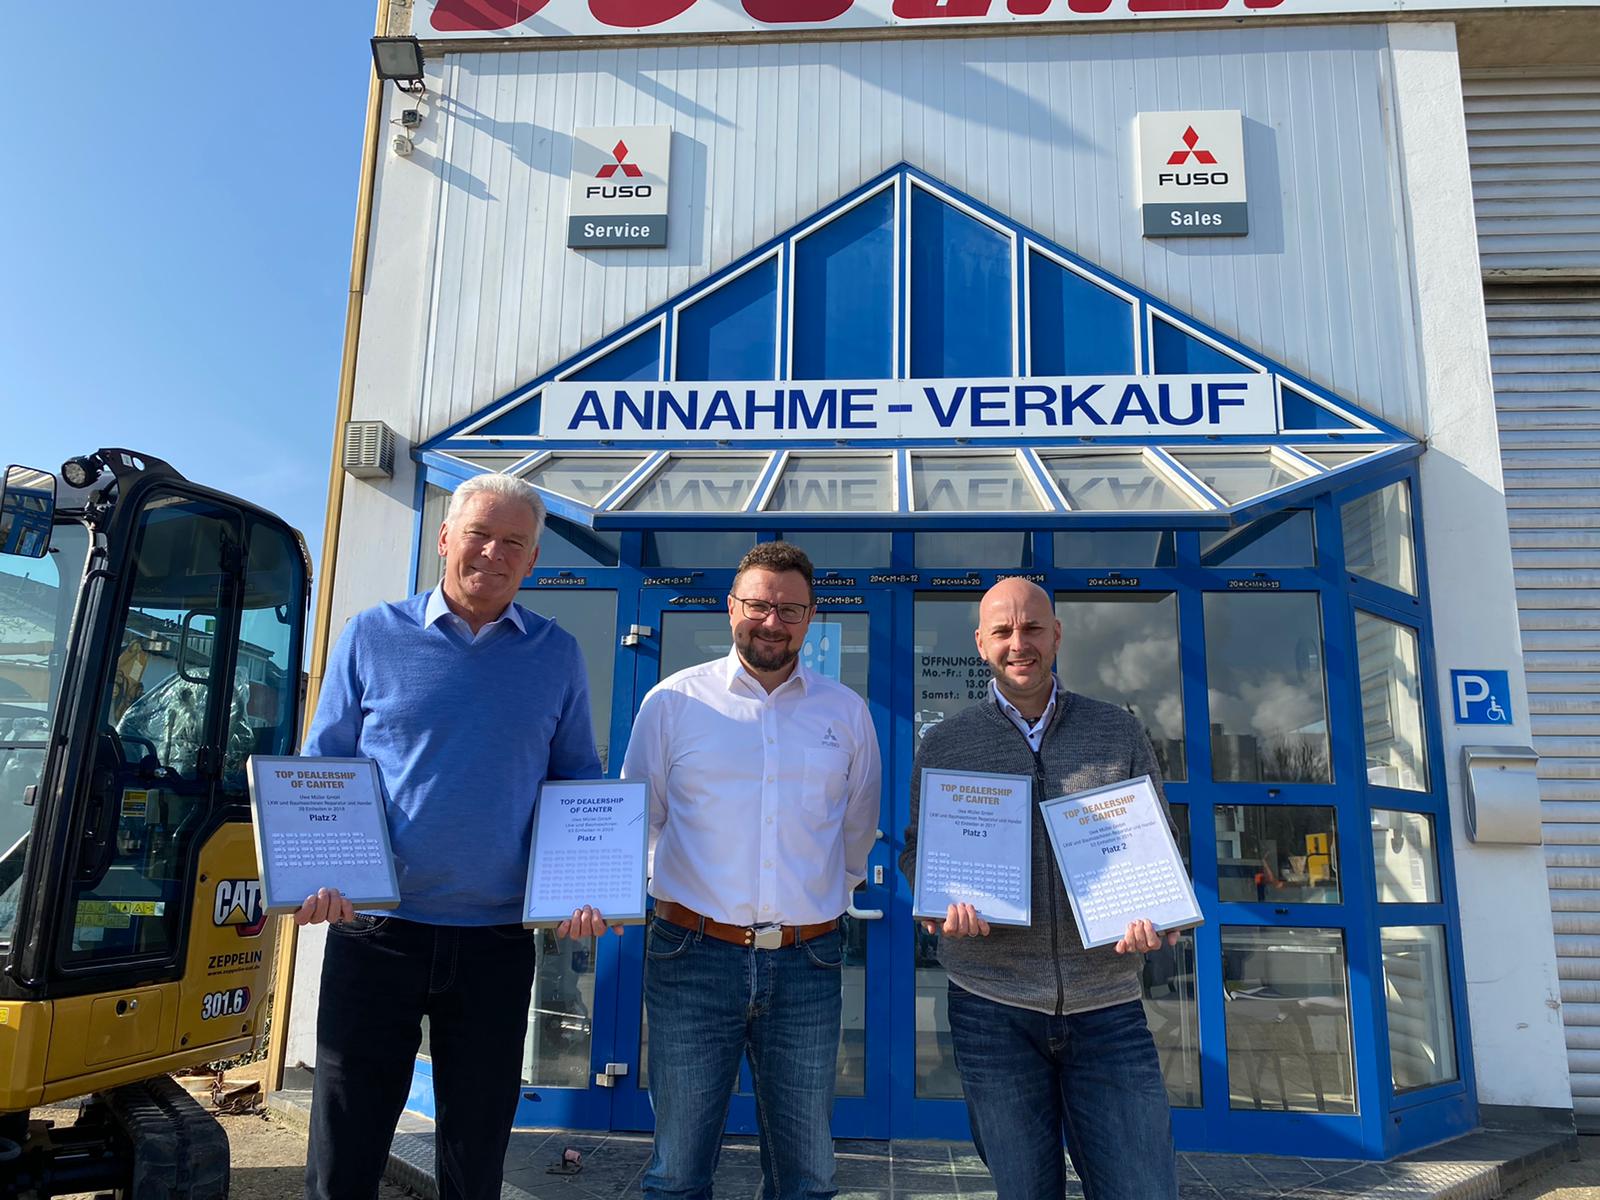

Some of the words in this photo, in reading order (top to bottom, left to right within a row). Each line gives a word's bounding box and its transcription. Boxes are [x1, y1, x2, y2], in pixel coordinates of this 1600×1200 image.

[1159, 172, 1228, 186] FUSO
[586, 185, 652, 199] FUSO
[1170, 211, 1222, 226] Sales
[584, 223, 650, 238] Service
[968, 668, 991, 677] 8.00
[922, 690, 960, 699] Samst.:
[1457, 676, 1490, 718] P
[275, 770, 294, 779] TOP
[297, 770, 357, 780] DEALERSHIP
[291, 780, 304, 789] OF
[306, 780, 345, 789] CANTER
[941, 783, 957, 792] TOP
[960, 785, 1013, 797] DEALERSHIP
[577, 797, 624, 805] DEALERSHIP
[953, 794, 964, 802] OF
[966, 795, 1000, 805] CANTER
[1063, 808, 1080, 820] TOP
[1082, 794, 1136, 815] DEALERSHIP
[1078, 817, 1089, 826] OF
[1092, 806, 1127, 822] CANTER
[963, 829, 981, 837] Platz
[982, 830, 988, 838] 3
[1102, 845, 1120, 855] Platz
[1121, 842, 1127, 850] 2
[213, 880, 260, 925] CAT
[208, 950, 262, 970] ZEPPELIN
[202, 988, 244, 1020] 301.6
